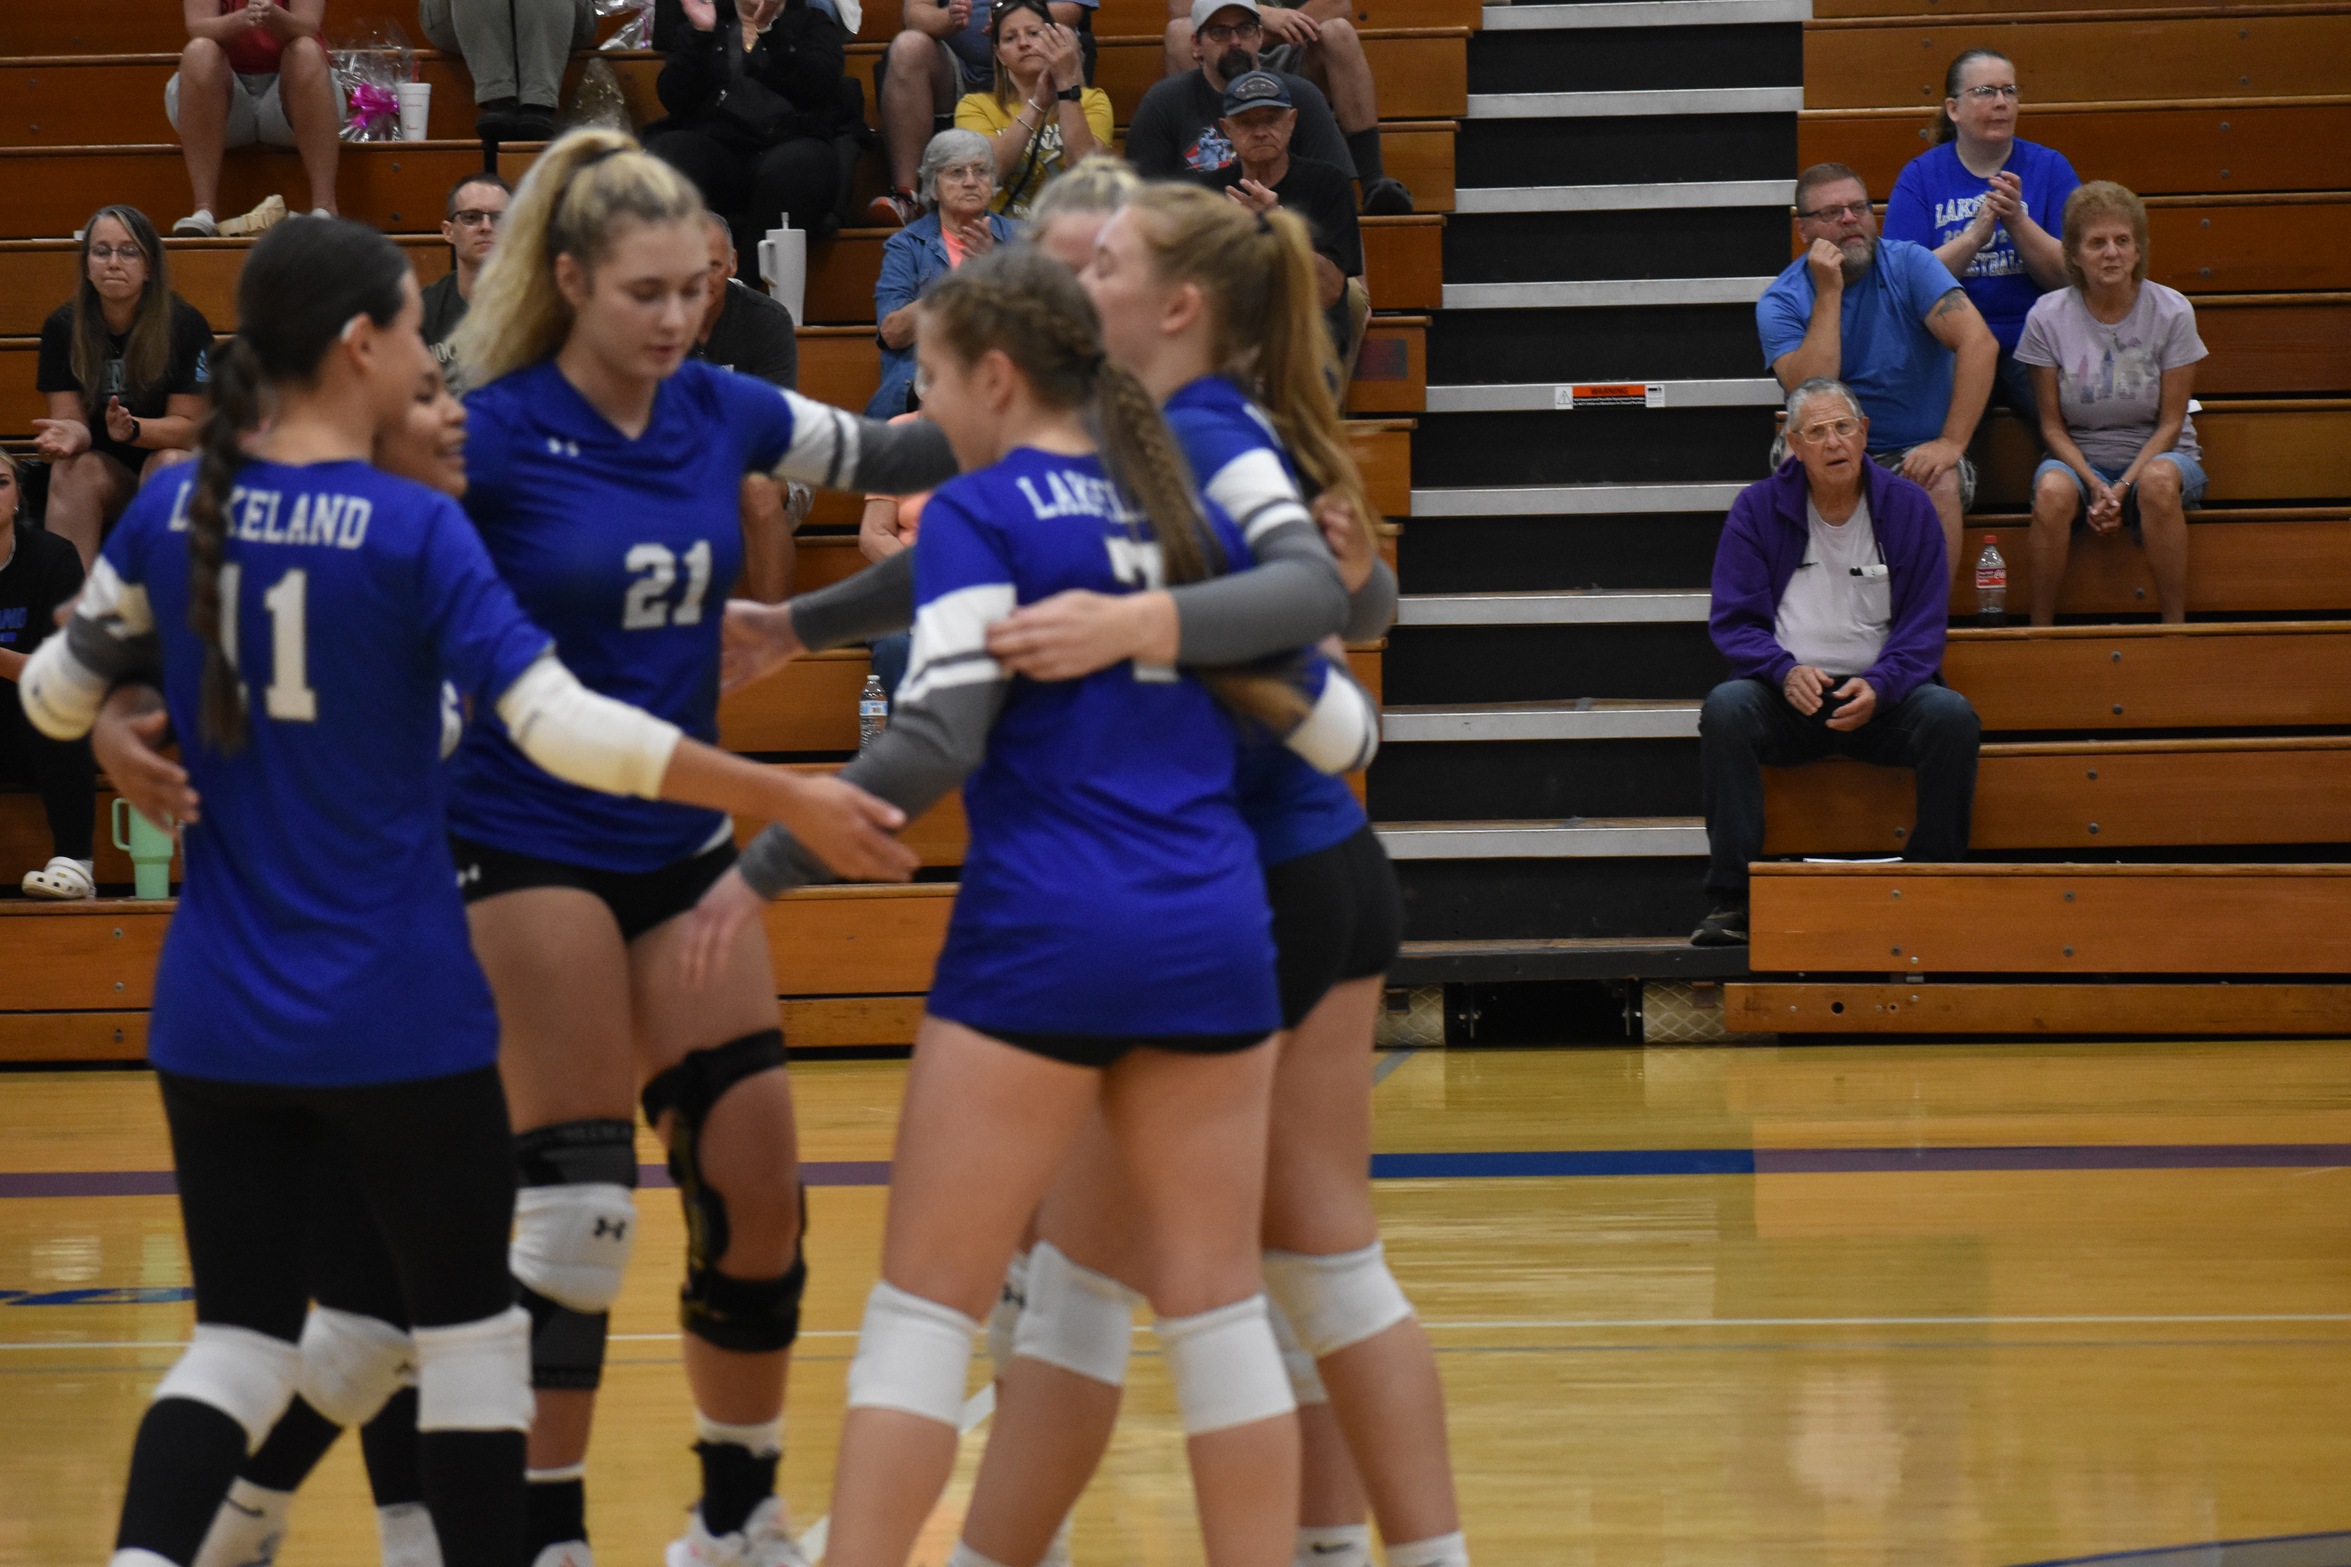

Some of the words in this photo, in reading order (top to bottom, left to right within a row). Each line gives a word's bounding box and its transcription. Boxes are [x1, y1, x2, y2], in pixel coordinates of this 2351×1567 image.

[1591, 386, 1629, 396] WARNING
[168, 479, 373, 550] LKELAND
[623, 539, 712, 630] 21
